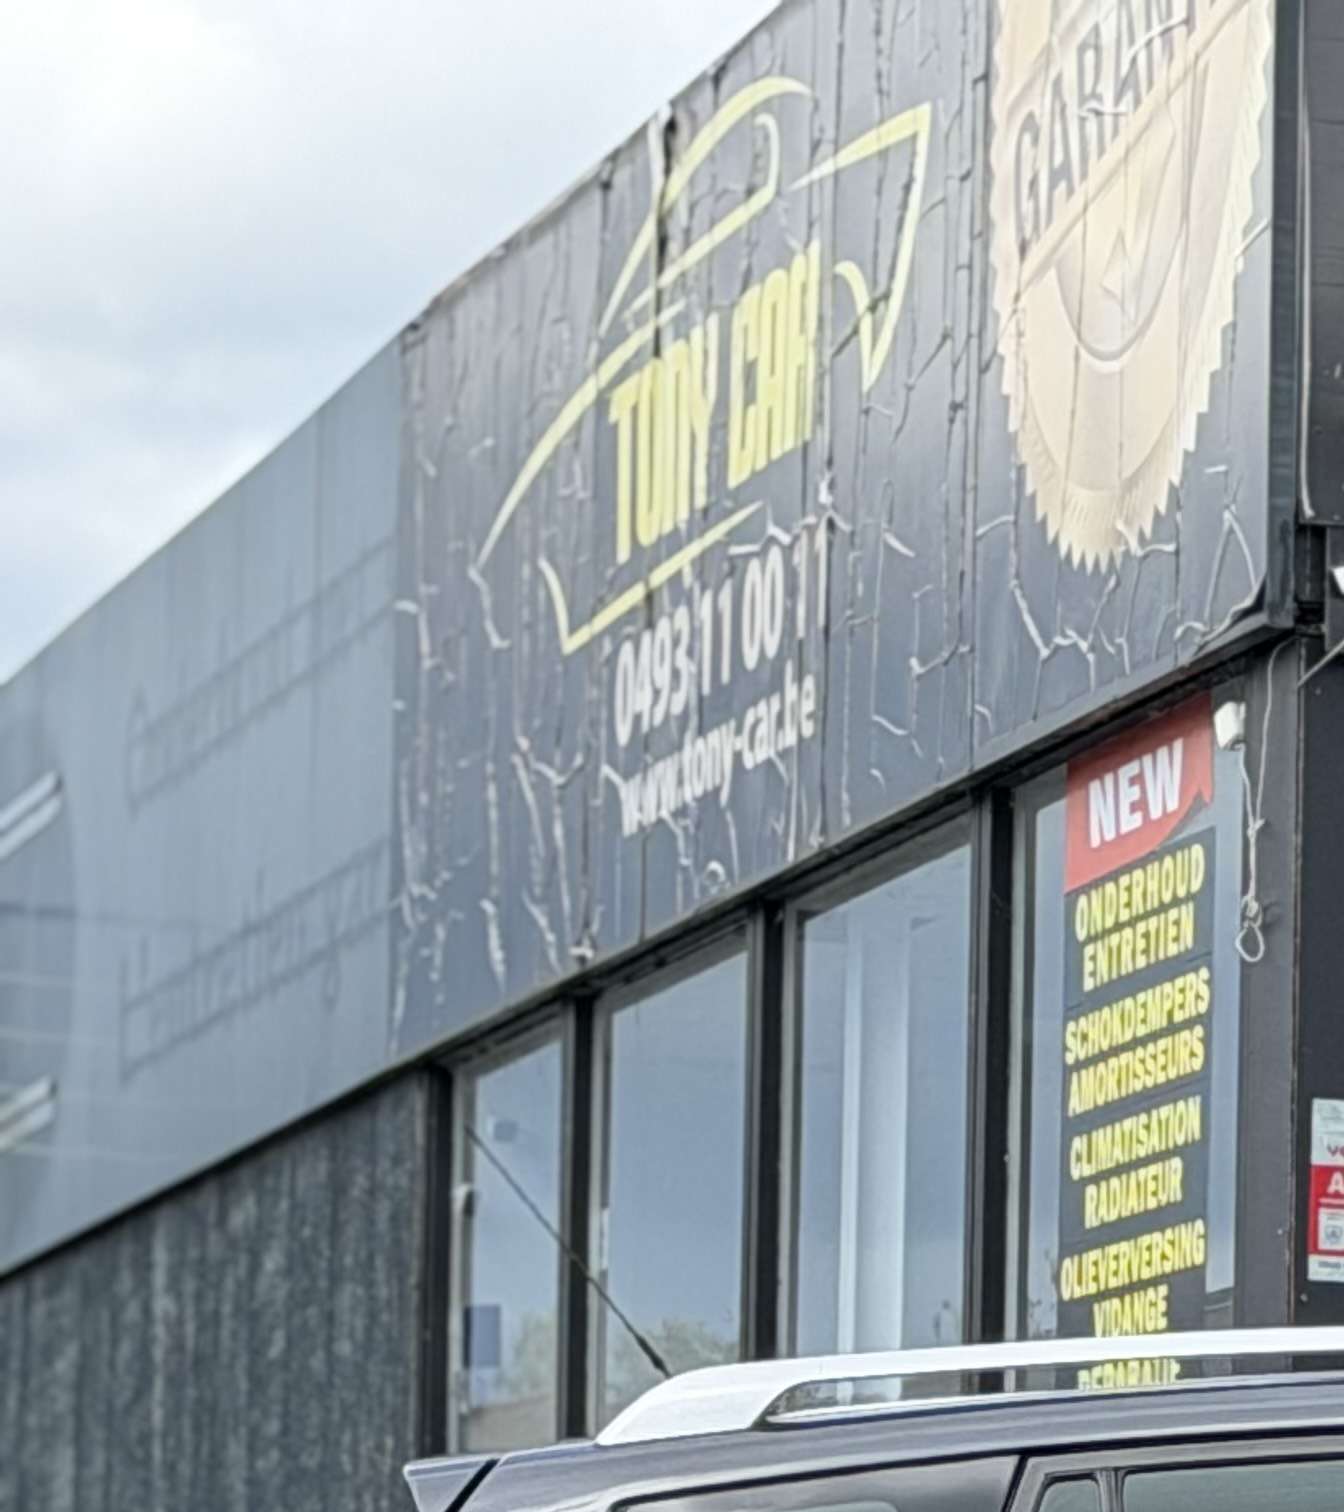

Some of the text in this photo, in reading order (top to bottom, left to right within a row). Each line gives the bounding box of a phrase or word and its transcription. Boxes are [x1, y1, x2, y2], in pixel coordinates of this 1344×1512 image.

[609, 237, 821, 564] TONY CAR
[615, 604, 690, 748] 0493
[700, 577, 733, 697] 11
[741, 544, 784, 672] 00
[1088, 738, 1184, 849] NEW
[1075, 843, 1206, 943] ONDERHOUD
[1083, 900, 1195, 993] ENTRETIEN
[1065, 965, 1211, 1066] SCHOKDEMPERS
[1068, 1024, 1205, 1118] AMORTISSEURS
[1070, 1095, 1202, 1181] CLIMATISATION
[1084, 1156, 1184, 1230] RADIATEUR
[1060, 1218, 1206, 1301] OLIEVERVERSING
[1093, 1283, 1169, 1338] VIDANGE
